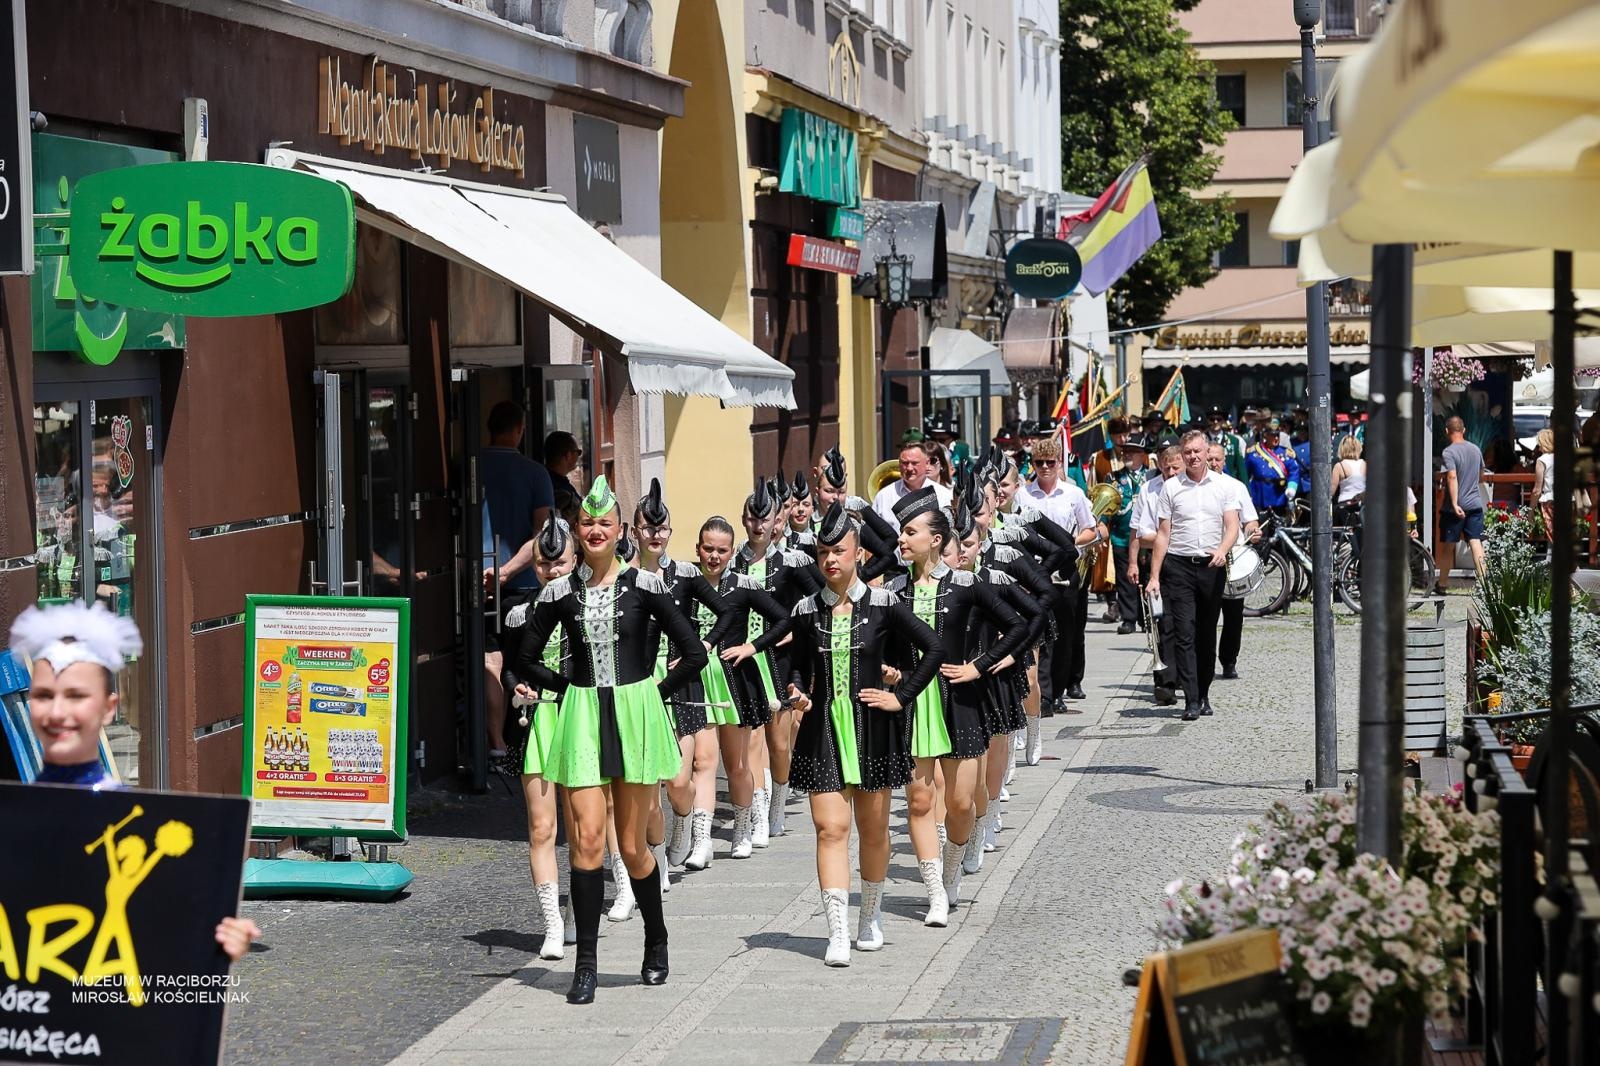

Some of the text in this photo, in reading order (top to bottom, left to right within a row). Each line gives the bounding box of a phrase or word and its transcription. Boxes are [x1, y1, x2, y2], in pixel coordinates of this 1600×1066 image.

[320, 55, 421, 160] Manufaktura
[423, 82, 469, 168] Lodów
[98, 196, 319, 263] żabka
[1238, 321, 1367, 347] Prezeów
[303, 649, 347, 659] WEEKEND
[315, 685, 339, 693] OREO
[317, 701, 346, 709] OREO
[0, 984, 50, 1014] ÓRZ
